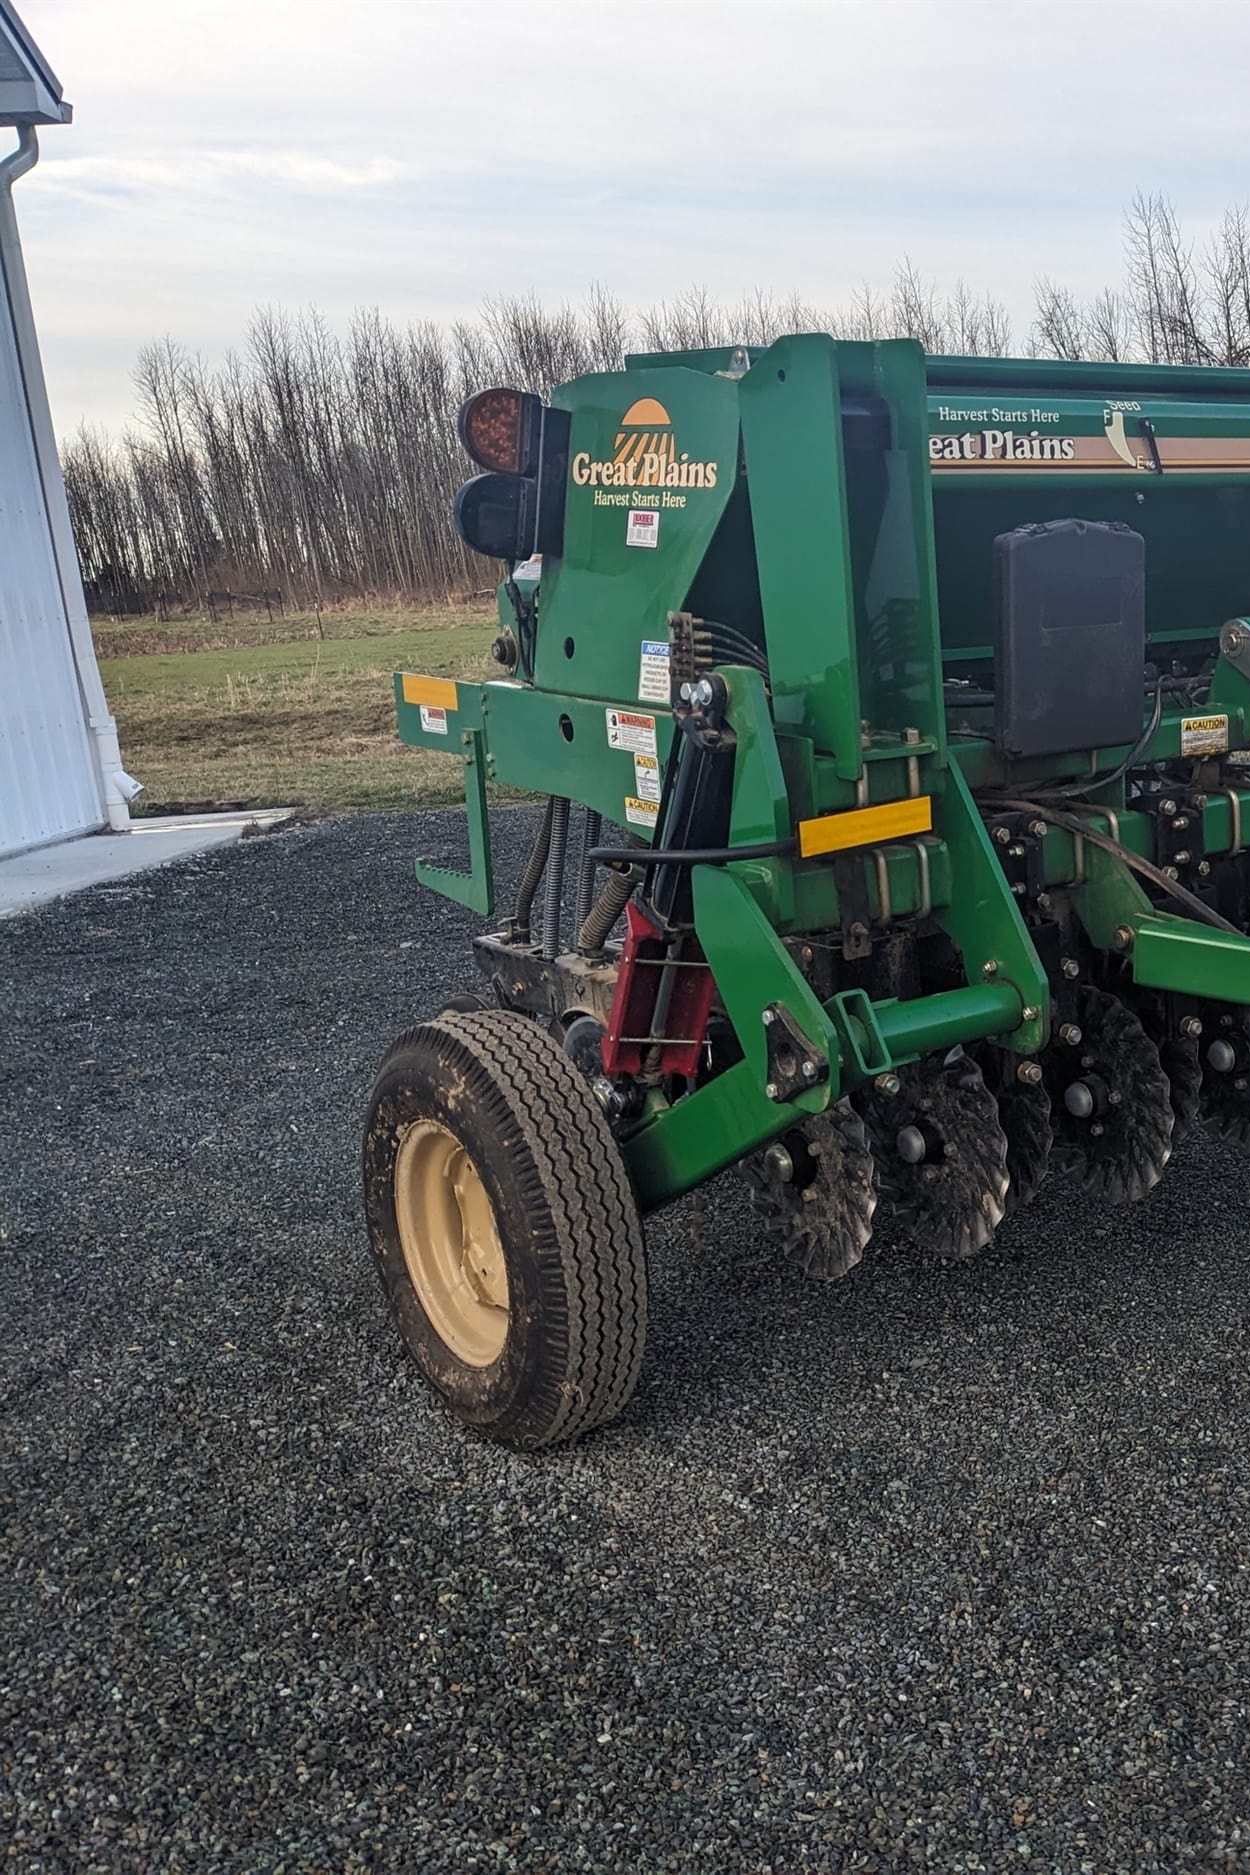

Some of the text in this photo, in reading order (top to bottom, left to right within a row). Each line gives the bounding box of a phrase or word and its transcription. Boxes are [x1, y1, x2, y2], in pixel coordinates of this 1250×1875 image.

[939, 407, 1060, 422] Harvest Starts Here
[1103, 409, 1110, 424] F
[929, 430, 1075, 459] eat Plains
[1137, 455, 1145, 469] E
[572, 452, 718, 488] Great Plains
[594, 490, 686, 507] Harvest Starts Here
[1192, 719, 1225, 729] CAUTION
[633, 800, 658, 813] CAUTION
